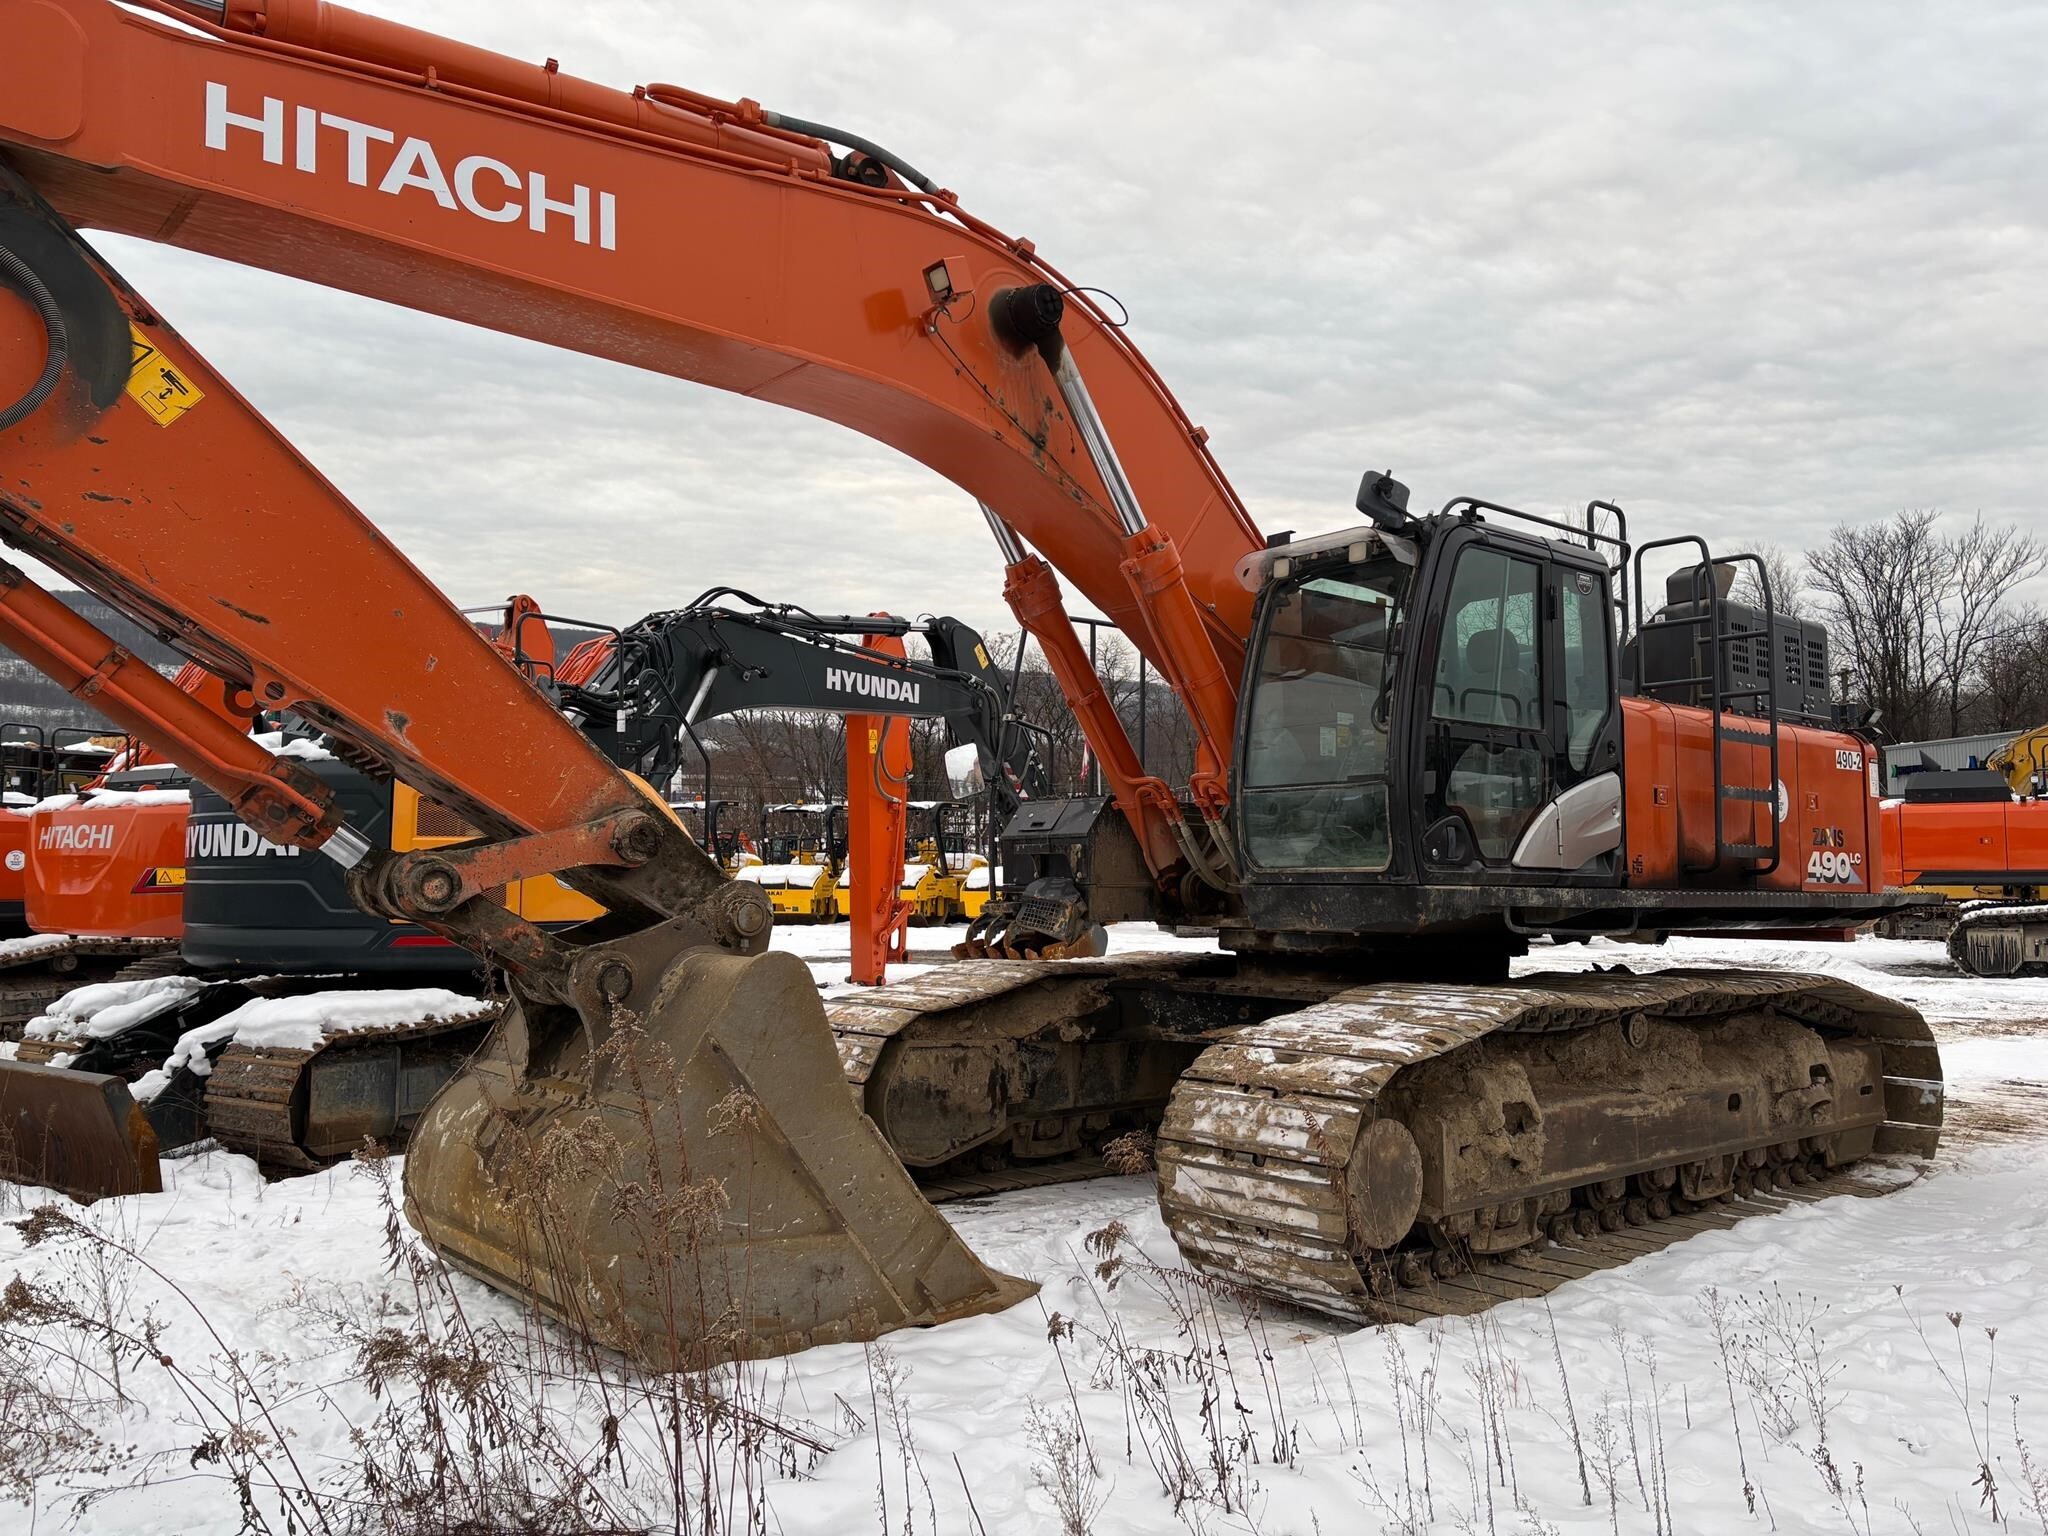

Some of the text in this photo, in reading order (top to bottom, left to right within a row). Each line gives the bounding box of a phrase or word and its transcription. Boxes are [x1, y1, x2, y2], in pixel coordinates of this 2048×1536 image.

[204, 80, 617, 251] HITACHI
[826, 667, 920, 704] HYUNDAI
[1836, 751, 1862, 770] 490-2
[38, 824, 114, 849] HITACHI
[1812, 827, 1844, 848] ZAXIS
